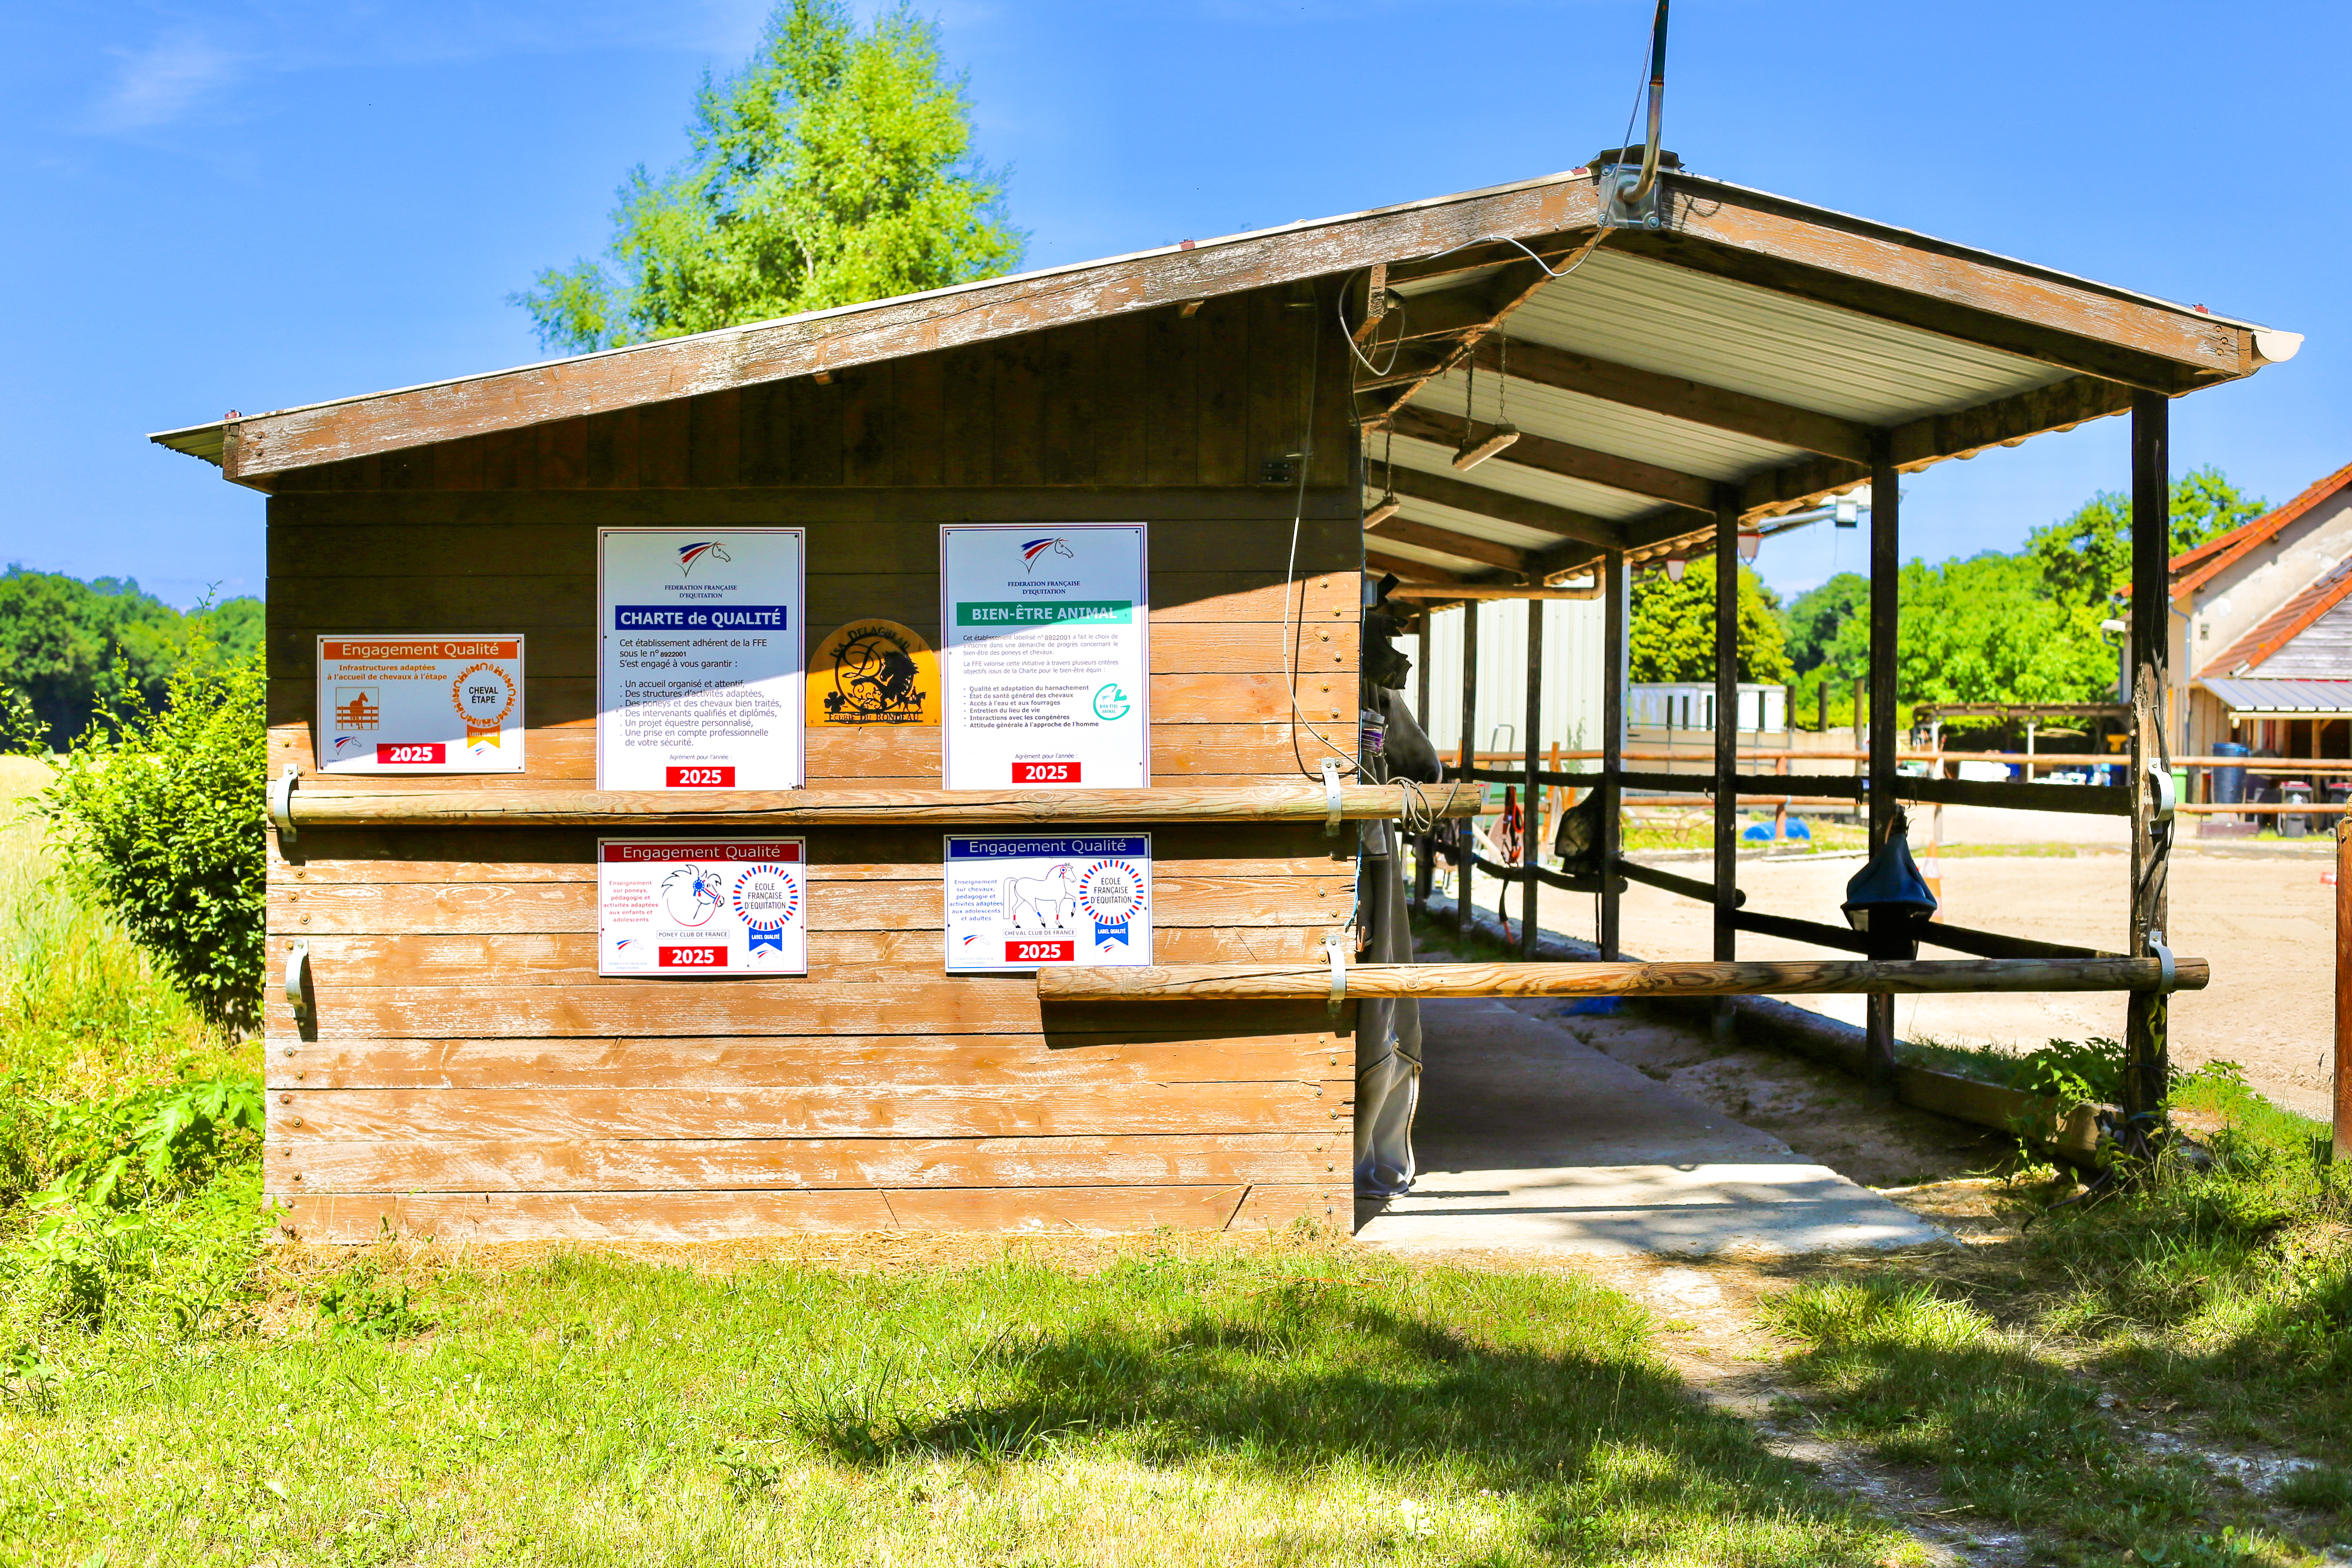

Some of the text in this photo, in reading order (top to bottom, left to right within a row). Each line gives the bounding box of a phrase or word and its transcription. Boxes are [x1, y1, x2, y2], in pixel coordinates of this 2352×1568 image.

[973, 604, 1117, 620] BIEN-ÊTRE ANIMAL
[621, 608, 780, 628] CHARTE de QUALITÉ
[636, 638, 690, 646] établissement
[692, 638, 728, 646] adhérent
[343, 643, 499, 658] Engagement Qualité
[400, 664, 435, 672] adaptées
[641, 659, 670, 669] engagé
[673, 659, 677, 667] à
[701, 660, 732, 669] garantir
[668, 679, 701, 689] organisé
[715, 680, 744, 688] attentif,
[469, 686, 498, 695] CHEVAL
[726, 689, 764, 698] adaptées,
[472, 695, 495, 703] ÉTAPE
[755, 699, 781, 708] traités,
[390, 747, 432, 761] 2025
[680, 769, 721, 784] 2025
[1026, 766, 1067, 780] 2025
[969, 839, 1126, 855] Engagement Qualité
[624, 845, 780, 861] Engagement Qualité
[755, 882, 775, 890] ÉCOLE
[1094, 887, 1128, 895] FRANÇAISE
[748, 892, 782, 901] FRANÇAISE
[745, 901, 785, 909] D'ÉQUITATION
[672, 949, 714, 964] 2025
[1019, 944, 1061, 959] 2025
